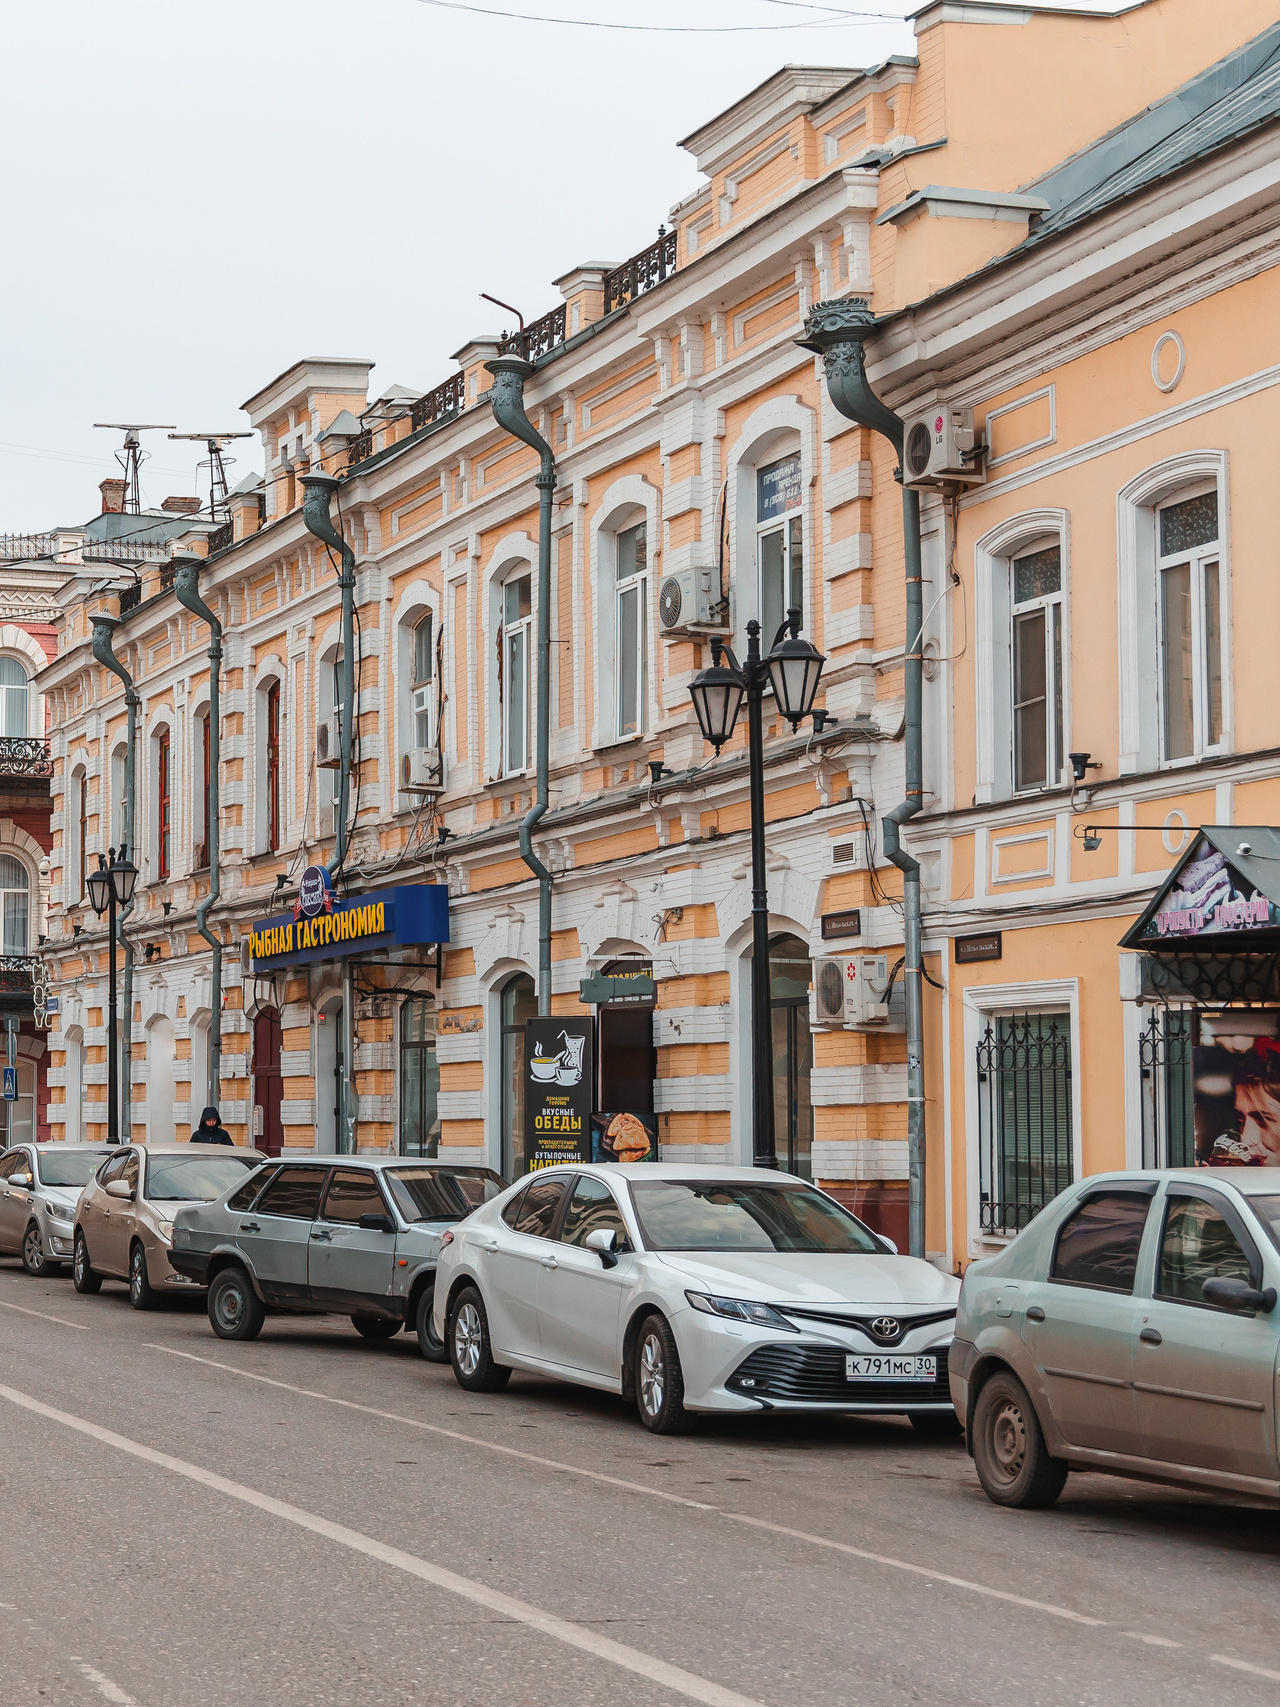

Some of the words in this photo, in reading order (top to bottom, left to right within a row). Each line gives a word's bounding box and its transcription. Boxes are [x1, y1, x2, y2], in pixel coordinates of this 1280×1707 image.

[935, 434, 943, 445] LG
[249, 923, 293, 959] РЫБНАЯ
[297, 901, 385, 950] ГАСТРОНОМИЯ
[542, 1108, 575, 1116] ВКУСНЫЕ
[535, 1115, 582, 1131] ОБЕДЫ
[535, 1151, 582, 1160] БУТЫЛОЧНЫЕ
[852, 1358, 912, 1374] К791МС
[916, 1358, 932, 1370] 30
